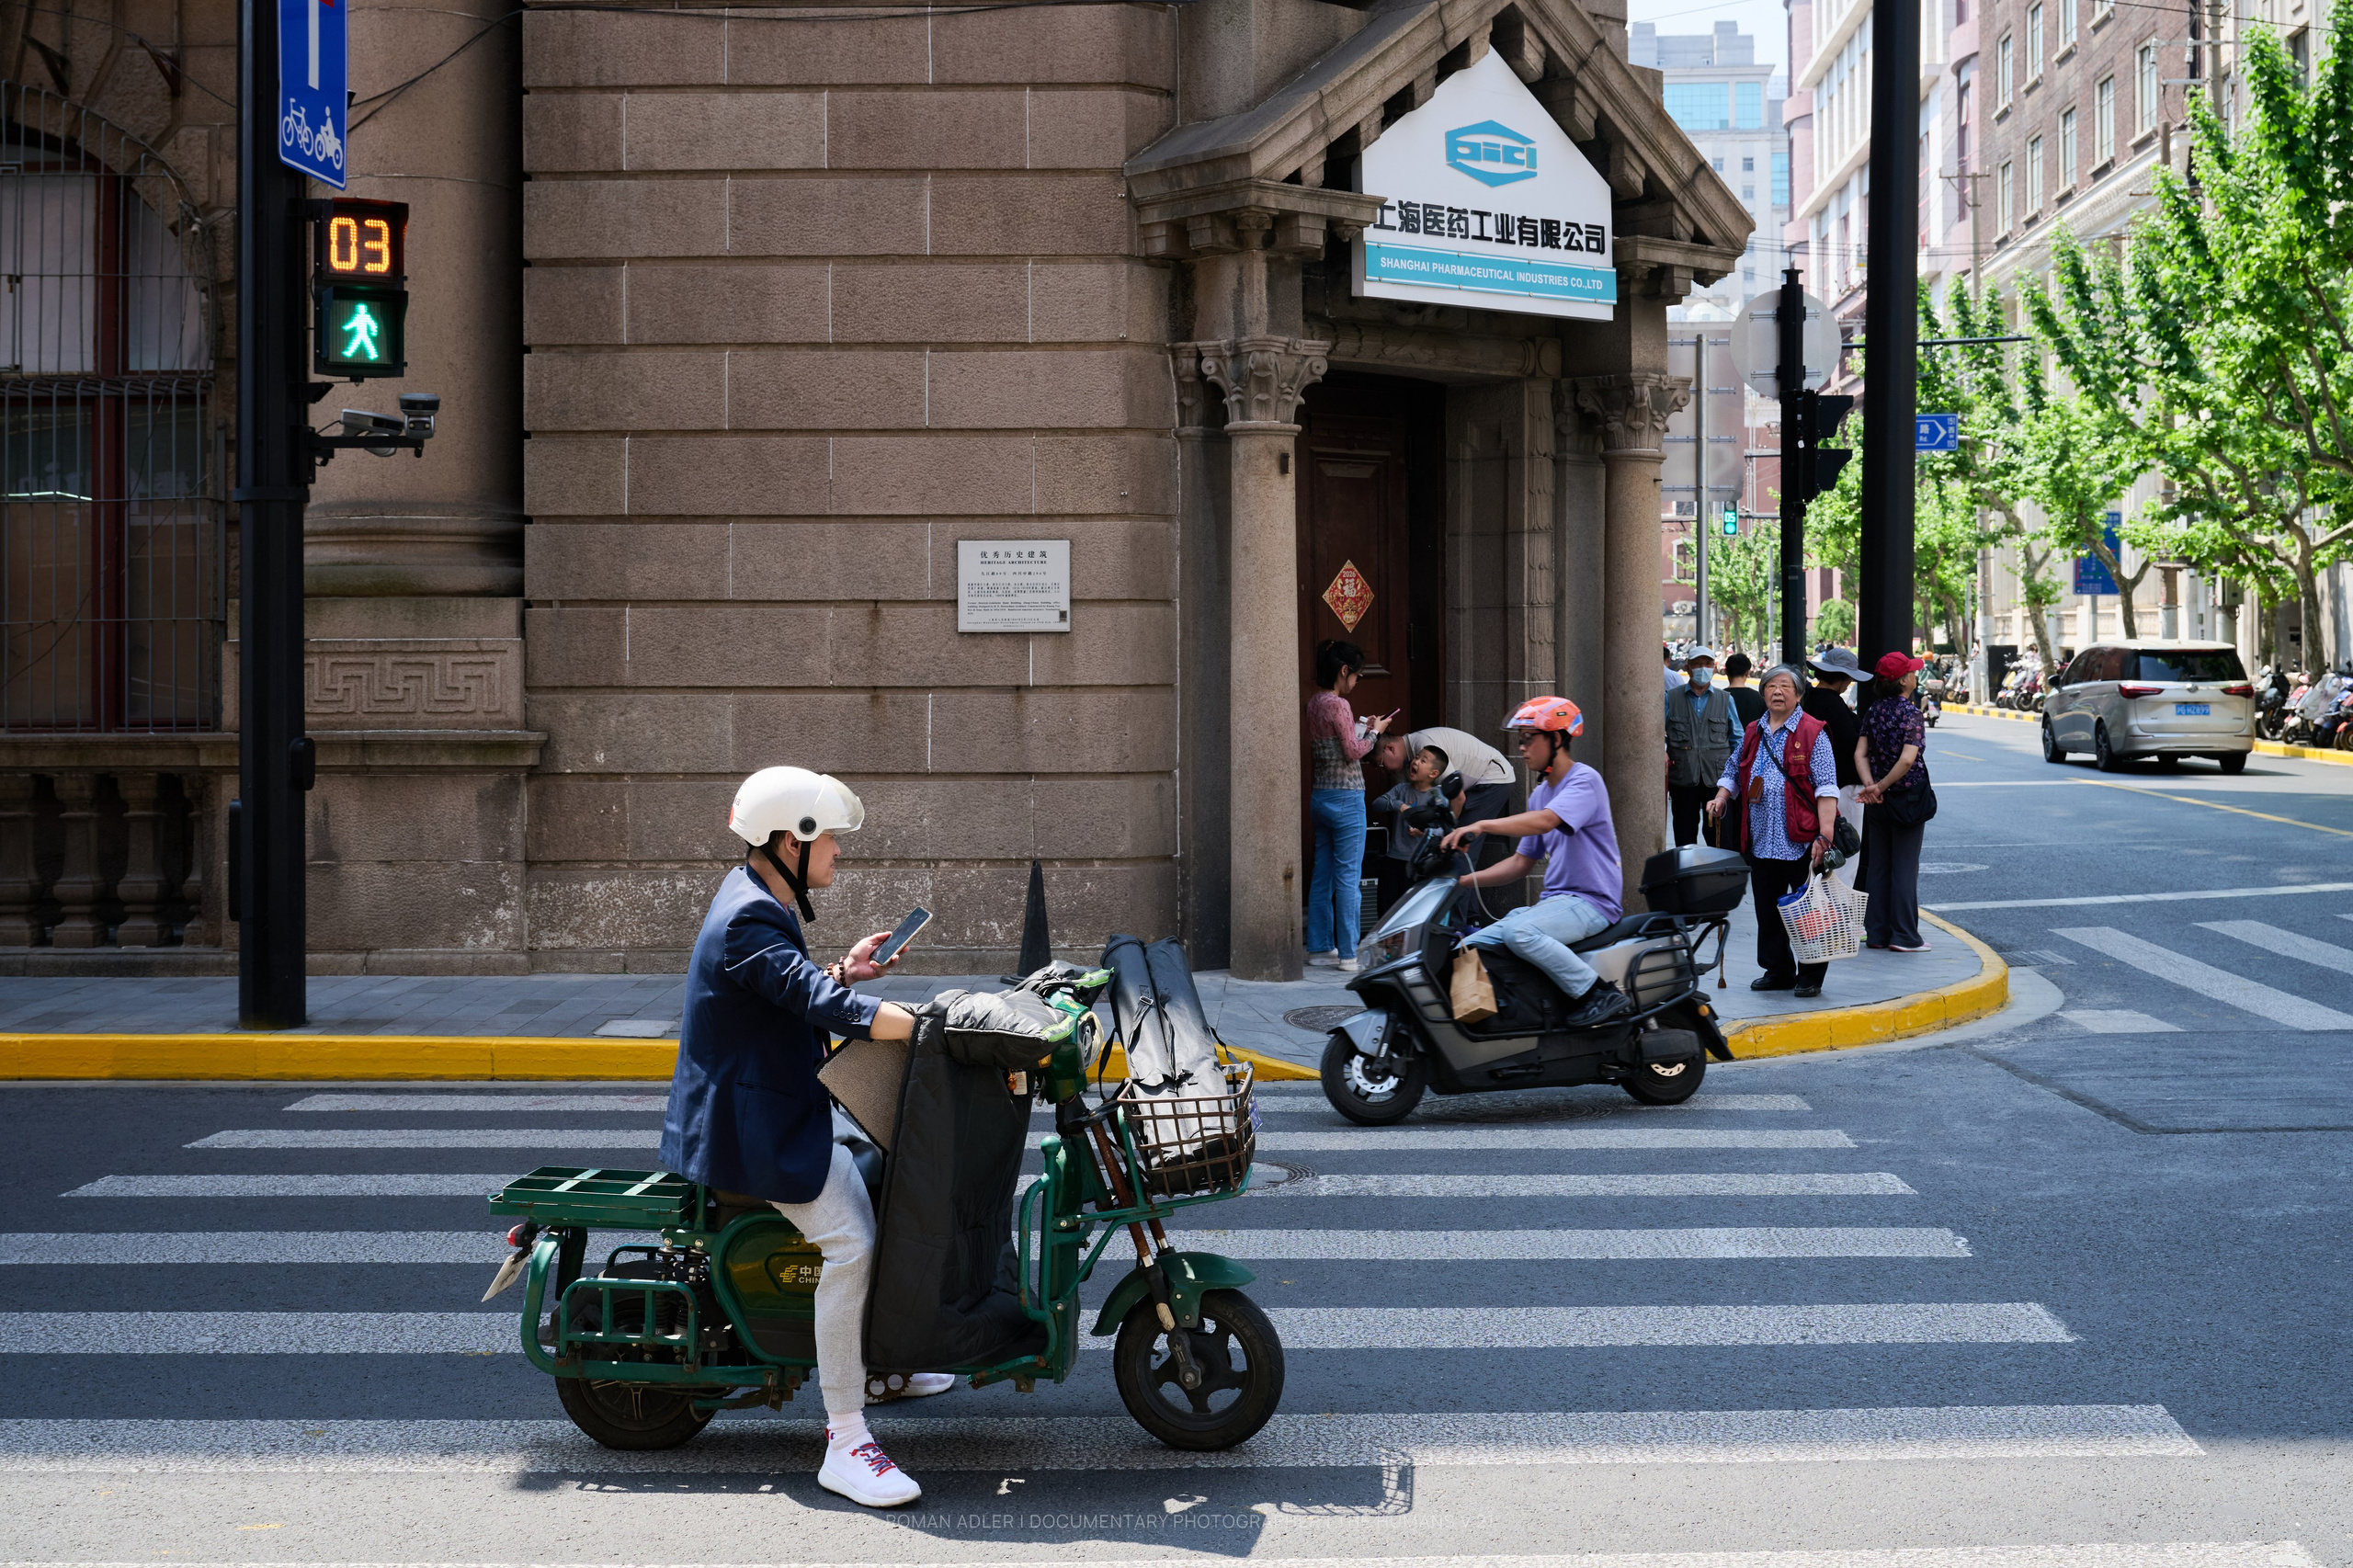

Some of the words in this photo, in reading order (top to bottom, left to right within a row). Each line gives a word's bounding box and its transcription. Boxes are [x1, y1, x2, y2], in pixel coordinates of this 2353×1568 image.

[1373, 199, 1606, 256] 上海医药工业有限公司
[330, 217, 391, 273] 03
[1380, 256, 1430, 273] SHANGHAI
[1432, 263, 1515, 282] PHARMACEUTICAL
[1517, 271, 1568, 287] INDUSTRIES
[1570, 277, 1603, 290] CO.,LTD
[1724, 511, 1736, 523] 05
[980, 551, 1047, 559] 优秀历史建筑
[1342, 570, 1357, 578] 2026
[1343, 578, 1357, 597] 福
